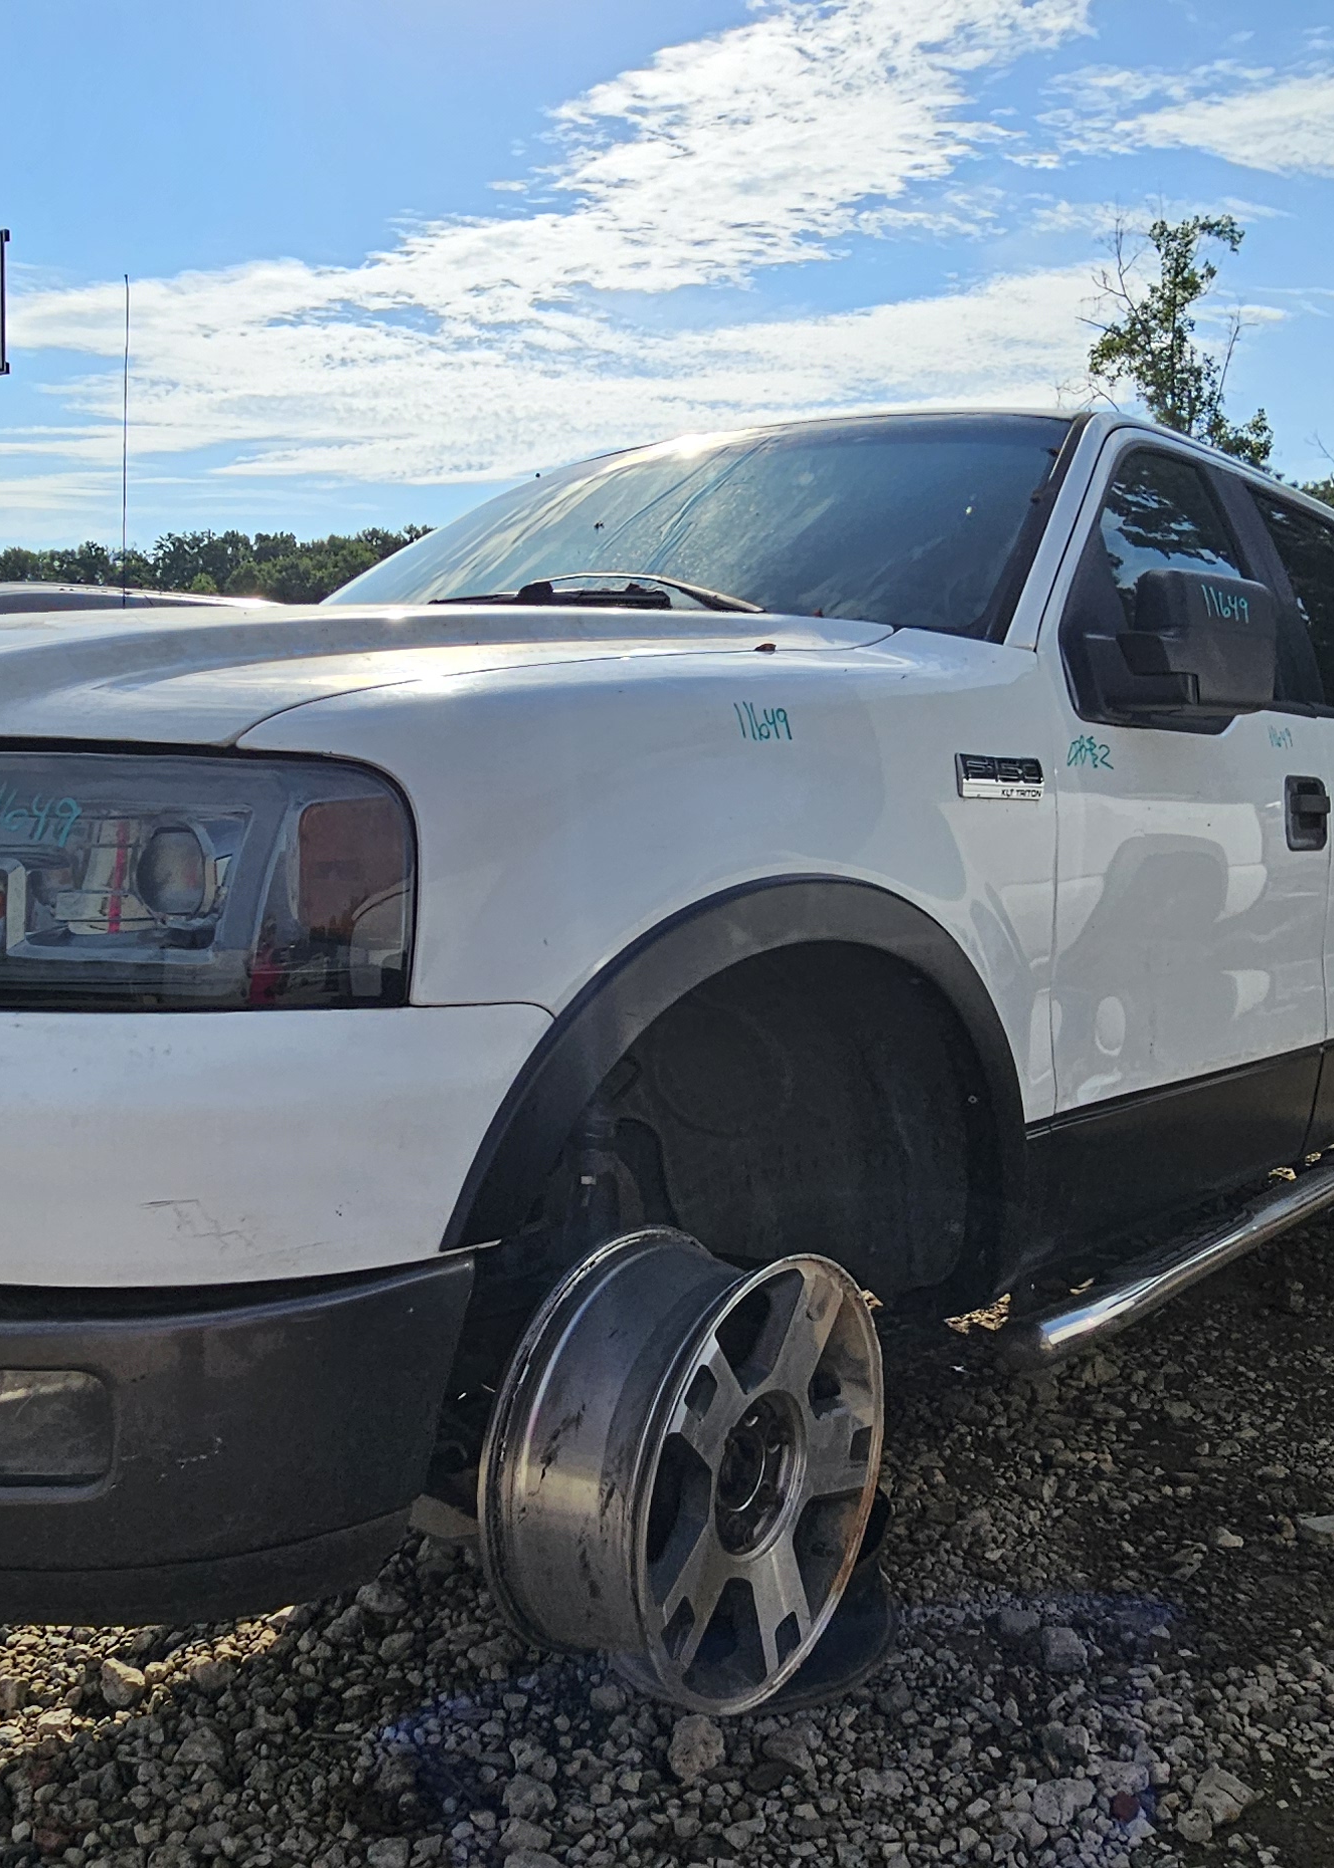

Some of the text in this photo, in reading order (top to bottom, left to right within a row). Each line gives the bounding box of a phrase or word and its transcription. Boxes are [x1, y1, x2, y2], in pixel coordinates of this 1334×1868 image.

[1201, 584, 1249, 624] 11649
[733, 701, 792, 740] 11649
[1016, 789, 1042, 798] TRITON
